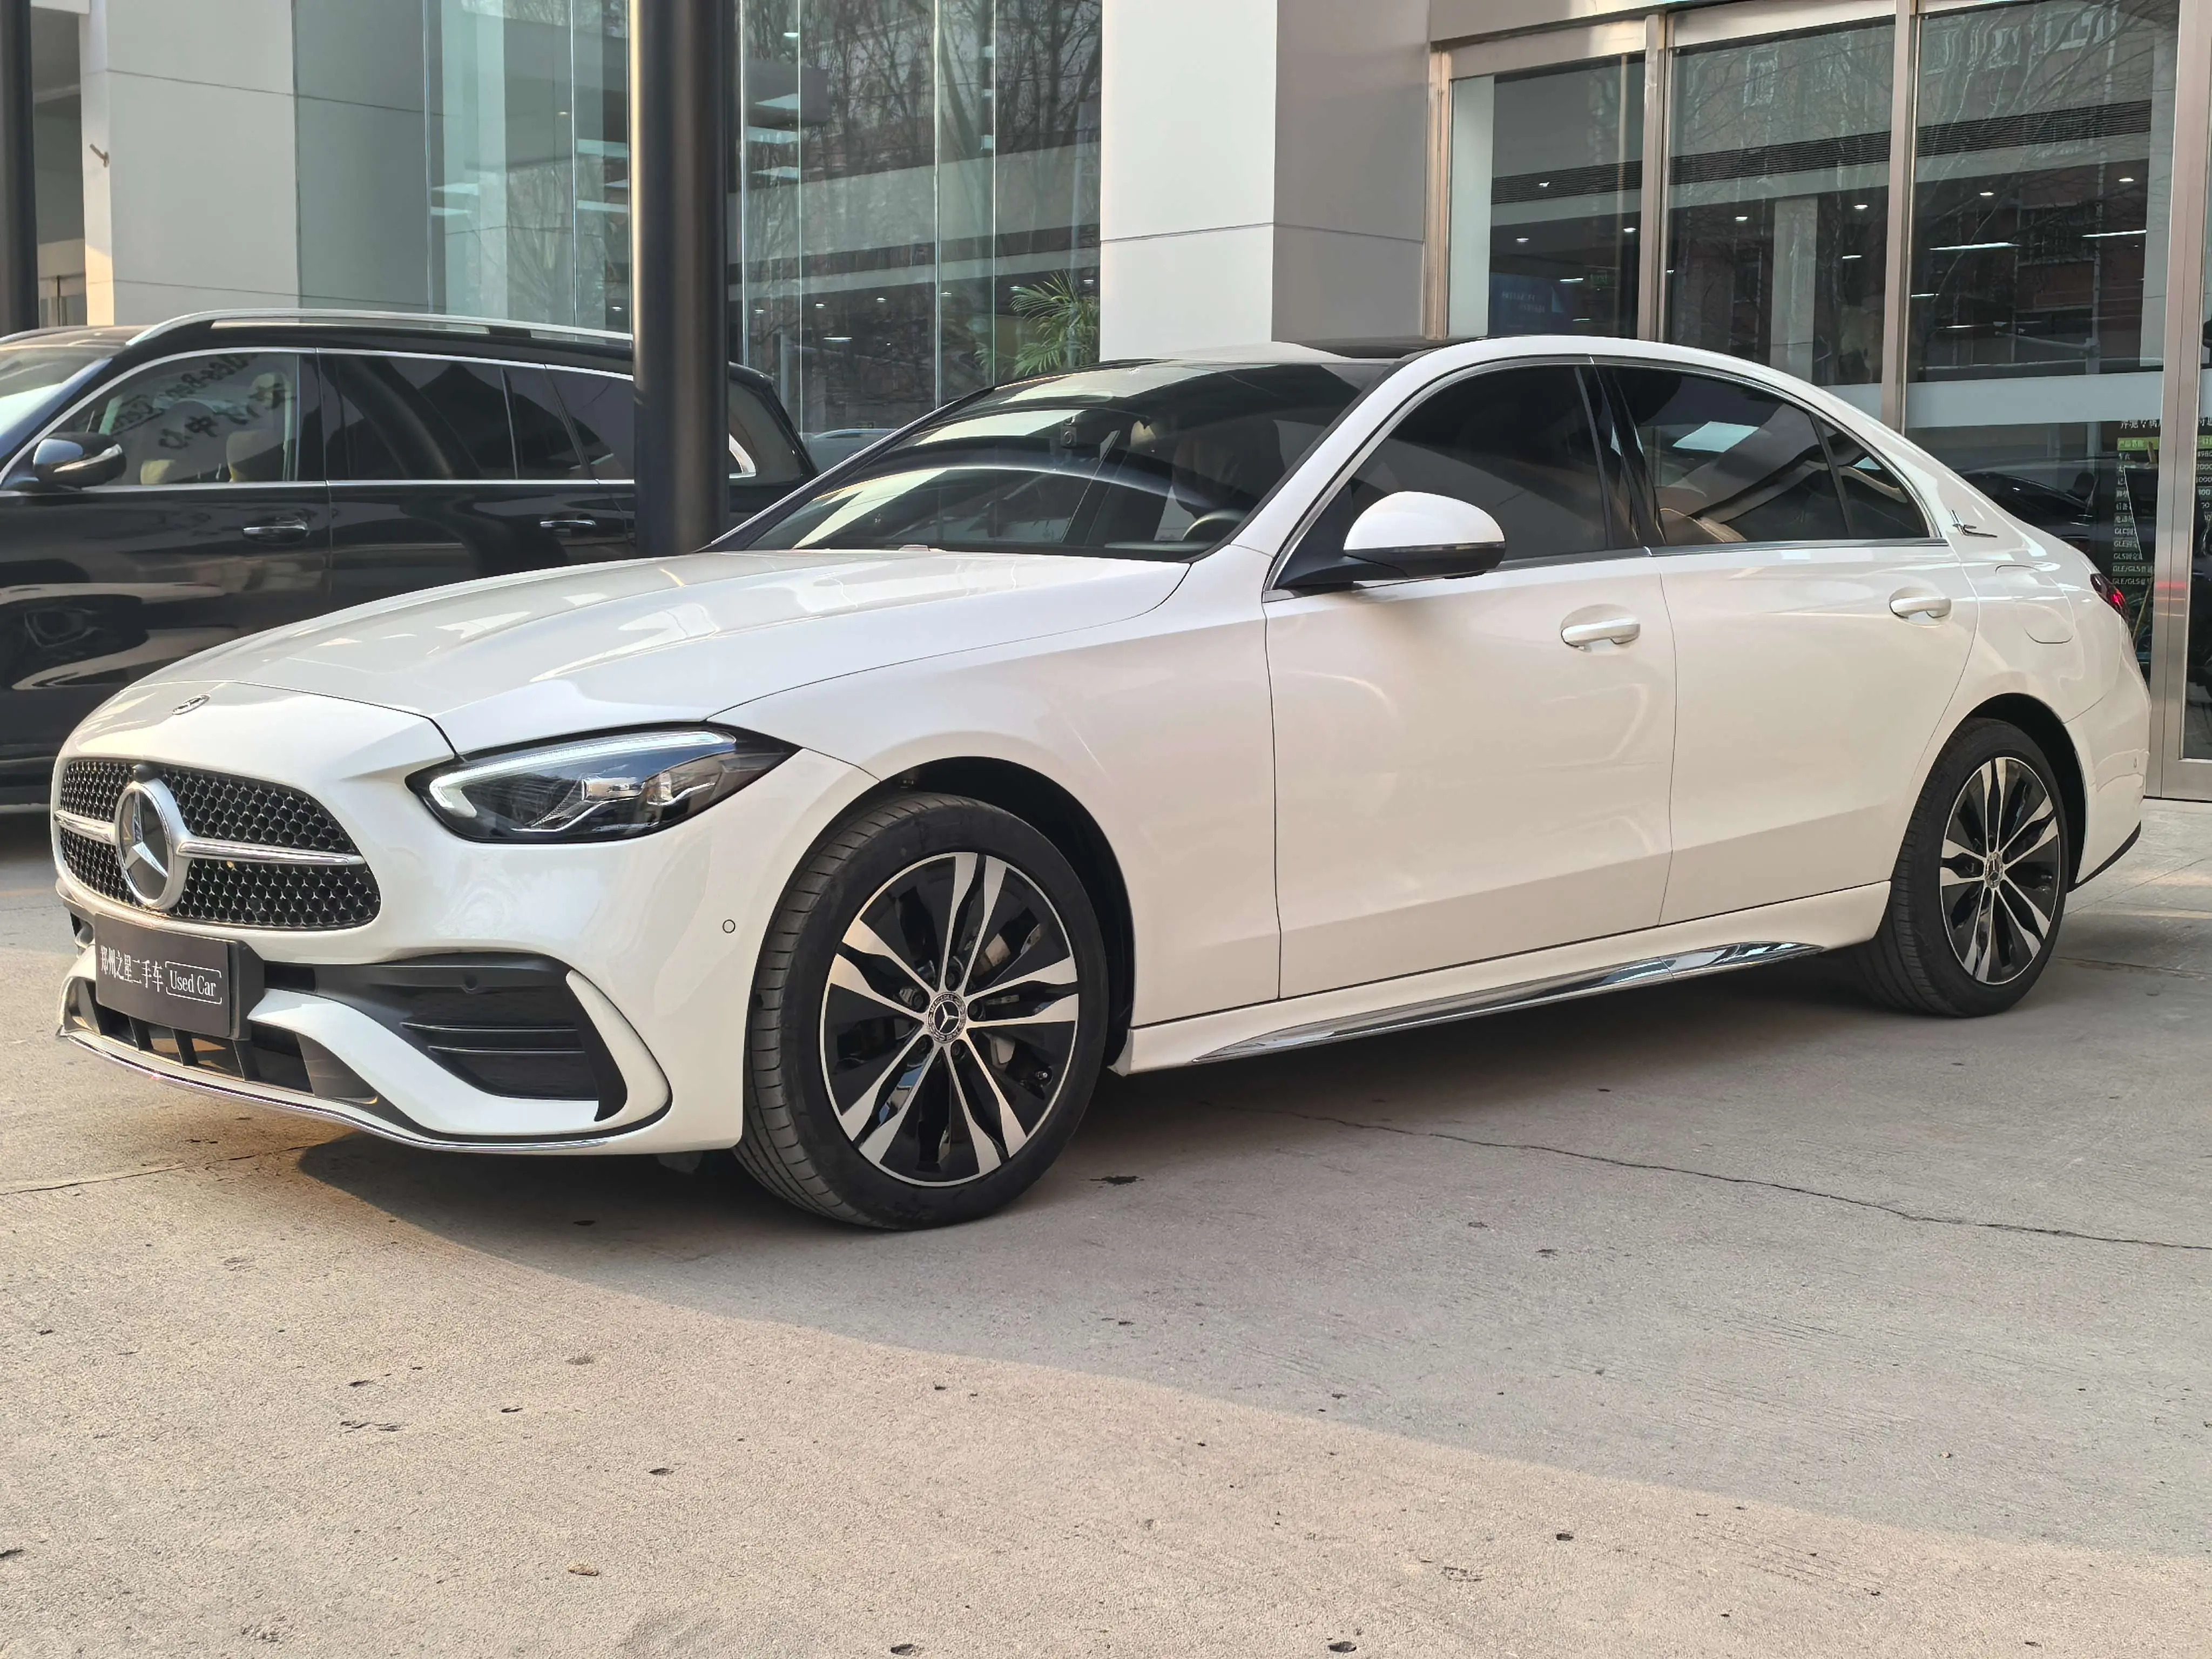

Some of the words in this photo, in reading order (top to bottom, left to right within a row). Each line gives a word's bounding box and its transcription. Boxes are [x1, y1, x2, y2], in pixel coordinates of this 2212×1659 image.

[100, 945, 164, 993] 郑州之星二手车
[170, 970, 195, 994] Used
[197, 976, 217, 996] Car
